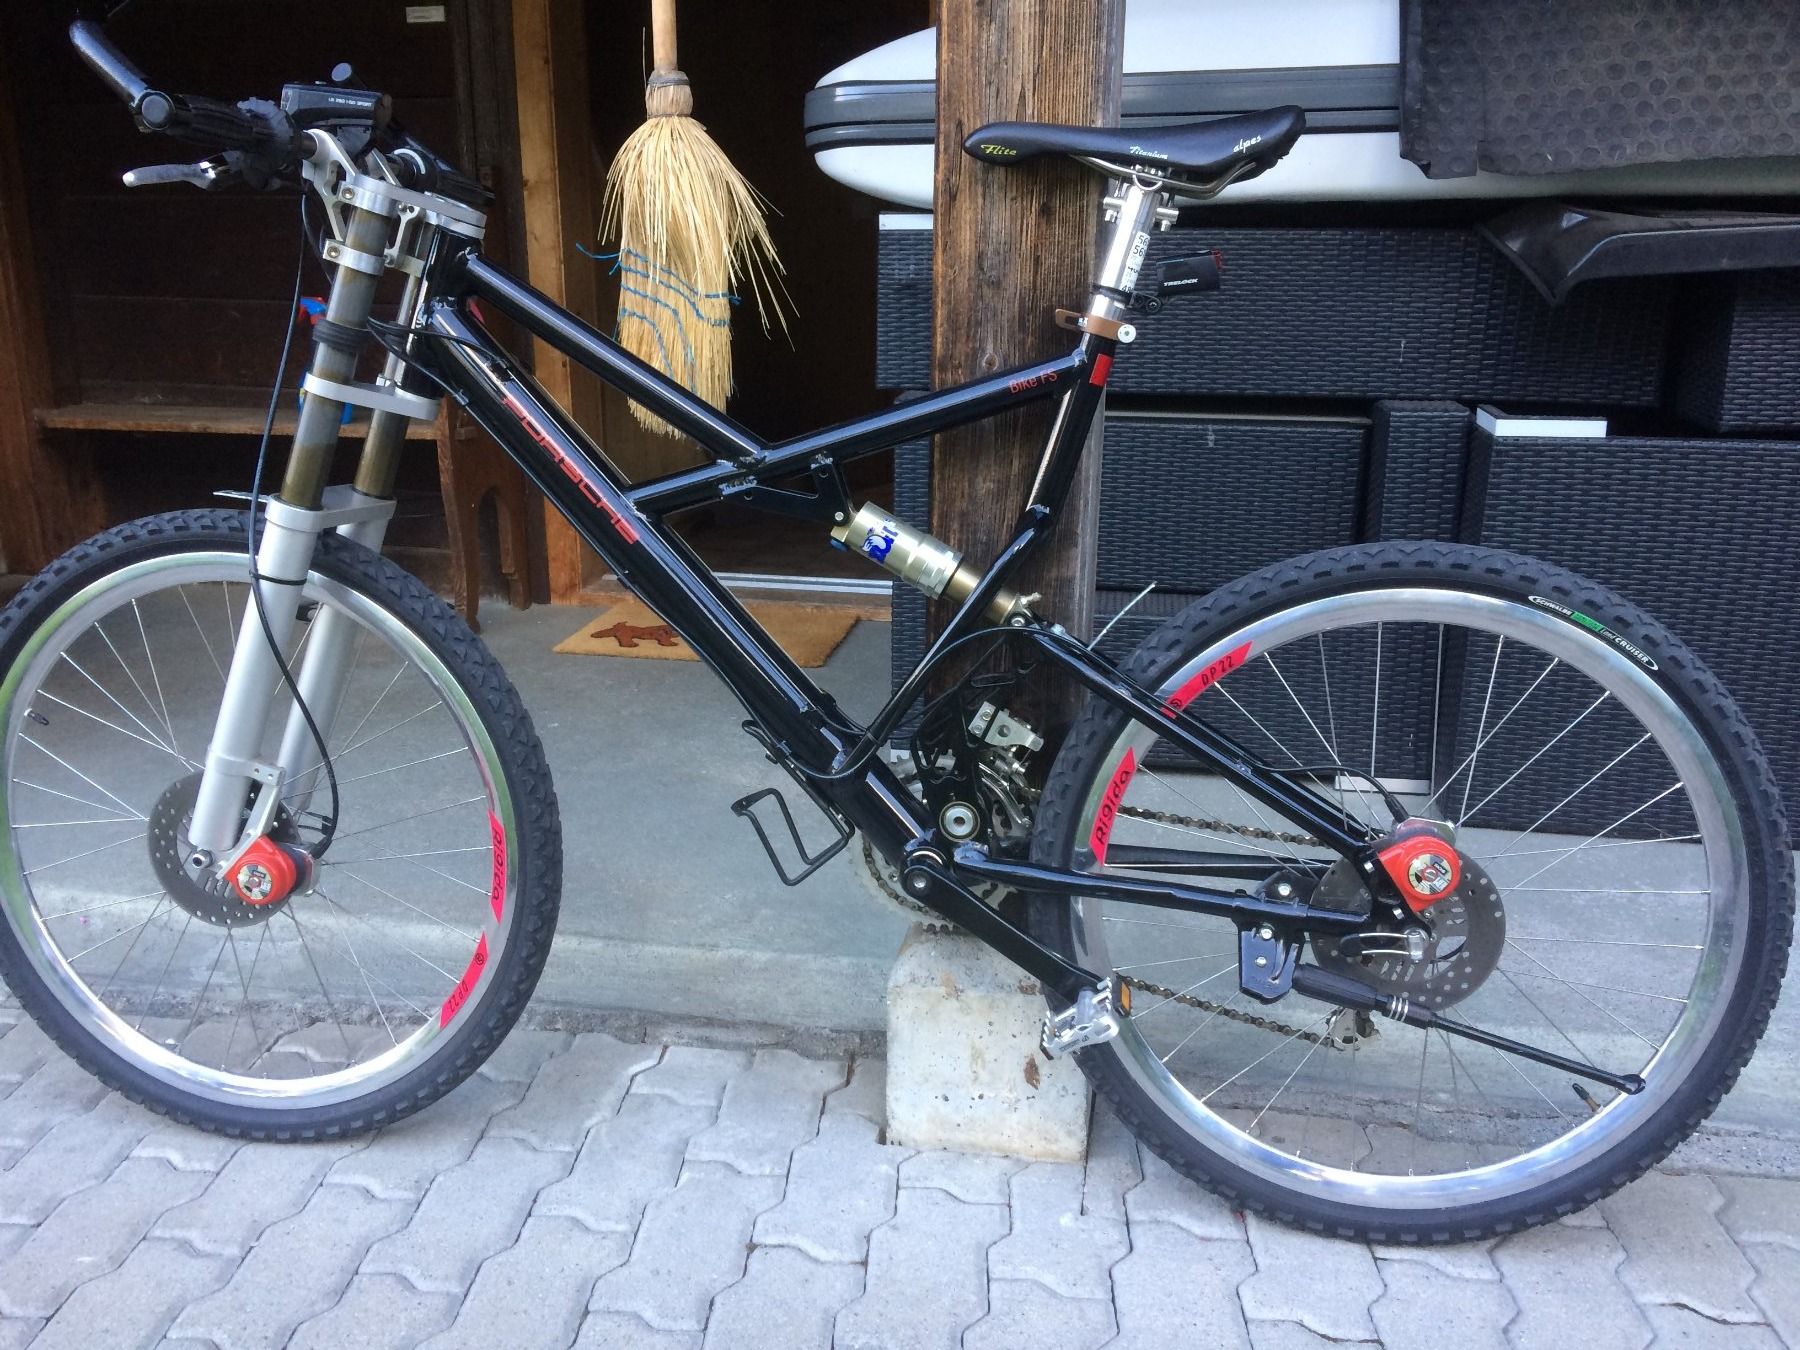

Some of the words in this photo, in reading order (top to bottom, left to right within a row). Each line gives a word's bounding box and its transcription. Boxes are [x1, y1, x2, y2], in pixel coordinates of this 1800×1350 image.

[981, 144, 1017, 156] Flite
[1129, 145, 1168, 160] Titanium
[1233, 135, 1262, 154] alpes
[1163, 278, 1199, 287] TRELOCK
[1009, 376, 1038, 393] Bike
[1040, 369, 1058, 384] FS
[502, 394, 640, 545] PORSCHE
[1615, 637, 1649, 664] CRUISER
[1219, 655, 1234, 673] 22
[1096, 770, 1131, 845] Rigida
